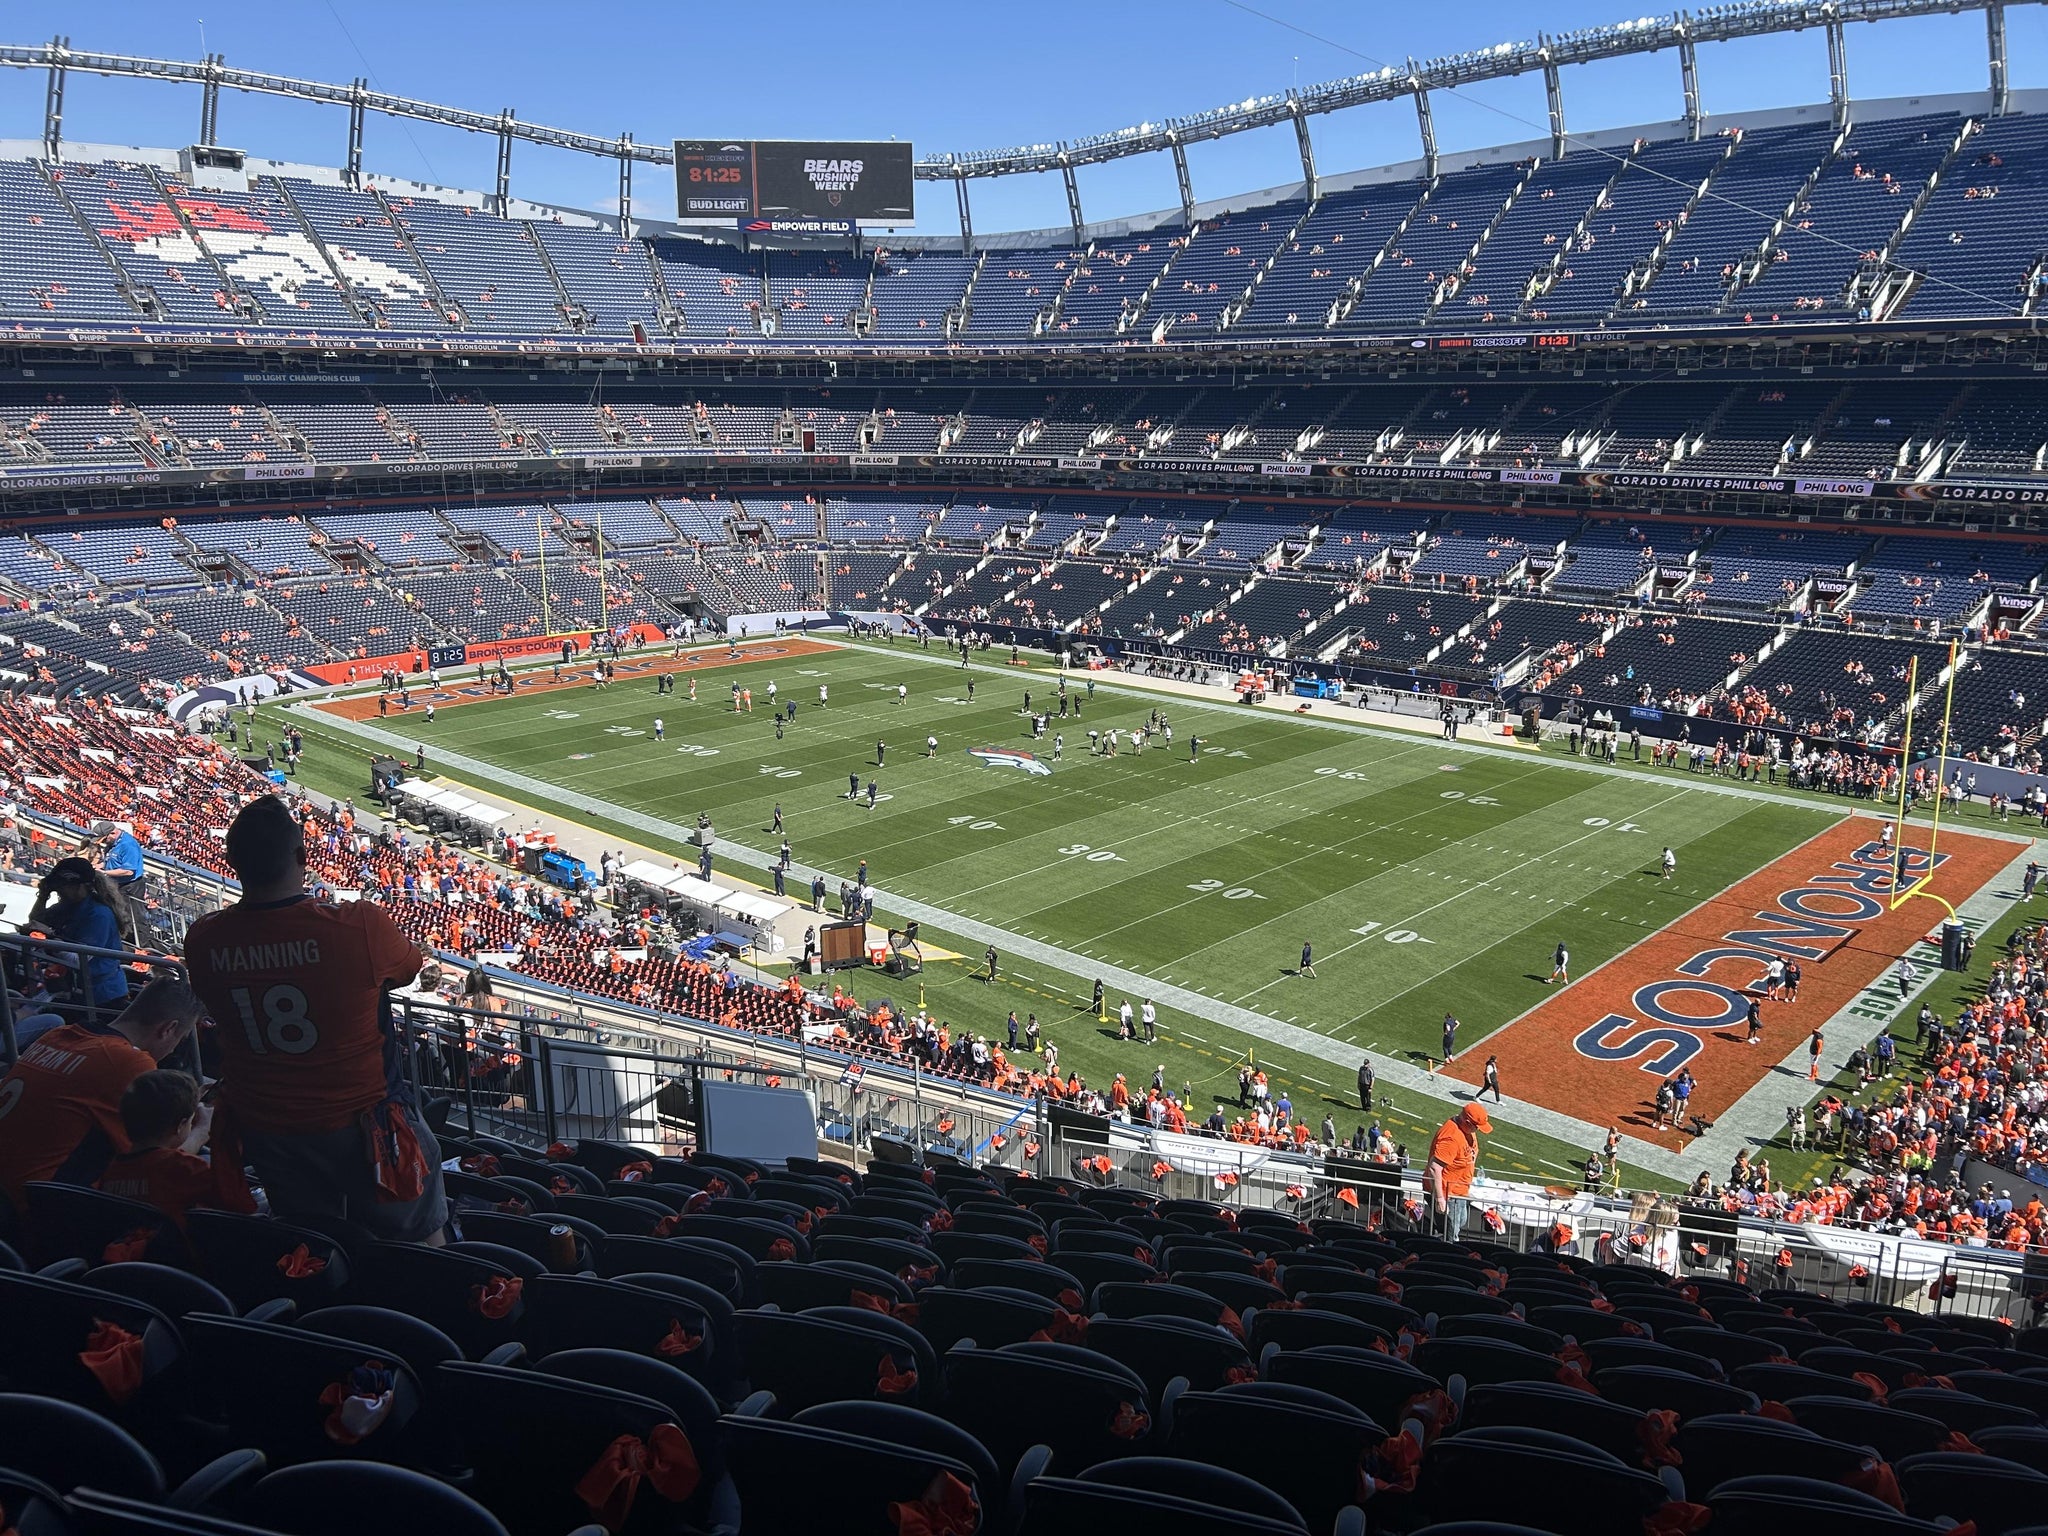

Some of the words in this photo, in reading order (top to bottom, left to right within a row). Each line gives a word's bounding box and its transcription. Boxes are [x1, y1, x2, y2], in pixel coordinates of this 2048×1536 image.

[804, 160, 864, 173] BEARS
[689, 167, 742, 183] 81:25
[808, 173, 859, 182] RUSHING
[814, 181, 841, 191] WEEK
[849, 182, 855, 191] 1
[689, 200, 713, 210] BUD
[714, 200, 746, 210] LIGHT
[771, 222, 821, 231] EMPOWER
[822, 222, 849, 231] FIELD
[1473, 337, 1527, 347] KICKOFF
[1539, 336, 1569, 346] 81:25
[1602, 333, 1626, 341] FOLEY
[387, 464, 440, 472] COLORADO
[442, 463, 473, 471] DRIVES
[475, 462, 495, 470] PHIL
[496, 461, 518, 469] LONG
[611, 458, 633, 466] LONG
[1179, 463, 1212, 471] DRIVES
[1234, 464, 1255, 472] LONG
[256, 469, 277, 477] PHIL
[279, 468, 304, 477] LONG
[1285, 465, 1305, 473] LONG
[1355, 468, 1399, 477] LORADO
[1402, 469, 1441, 478] DRIVES
[1443, 470, 1466, 479] PHIL
[1467, 470, 1492, 480] LONG
[63, 475, 102, 486] DRIVES
[105, 475, 130, 484] PHIL
[131, 473, 160, 483] LONG
[1506, 472, 1528, 480] PHIL
[1528, 472, 1554, 481] LONG
[1613, 475, 1668, 486] LORADO
[1672, 477, 1721, 489] DRIVES
[1723, 479, 1751, 490] PHIL
[1753, 480, 1784, 491] LONG
[1803, 482, 1832, 492] PHIL
[1832, 483, 1864, 493] LONG
[1942, 488, 2015, 500] LORADO
[2021, 490, 2048, 502] DR
[569, 530, 591, 538] Wings
[1009, 525, 1027, 533] Wings
[1181, 535, 1200, 544] Wings
[1286, 541, 1306, 550] Wings
[197, 555, 225, 565] Wings
[1531, 557, 1555, 568] Wings
[1660, 568, 1687, 579] Wings
[1817, 580, 1848, 593] Wings
[1998, 595, 2033, 609] Wings
[432, 649, 463, 663] 81:25
[469, 645, 522, 659] BRONCOS
[359, 663, 382, 674] THIS
[388, 661, 399, 670] IS
[1209, 652, 1249, 672] HIGH
[604, 725, 647, 737] 20
[677, 744, 721, 757] 30
[758, 764, 802, 779] 40
[947, 815, 998, 830] 40
[1058, 844, 1116, 861] 30
[1186, 879, 1254, 899] 20
[1349, 920, 1418, 944] 10
[210, 939, 321, 975] MANNING
[1573, 840, 1952, 1077] BRONCOS
[231, 984, 320, 1055] 18
